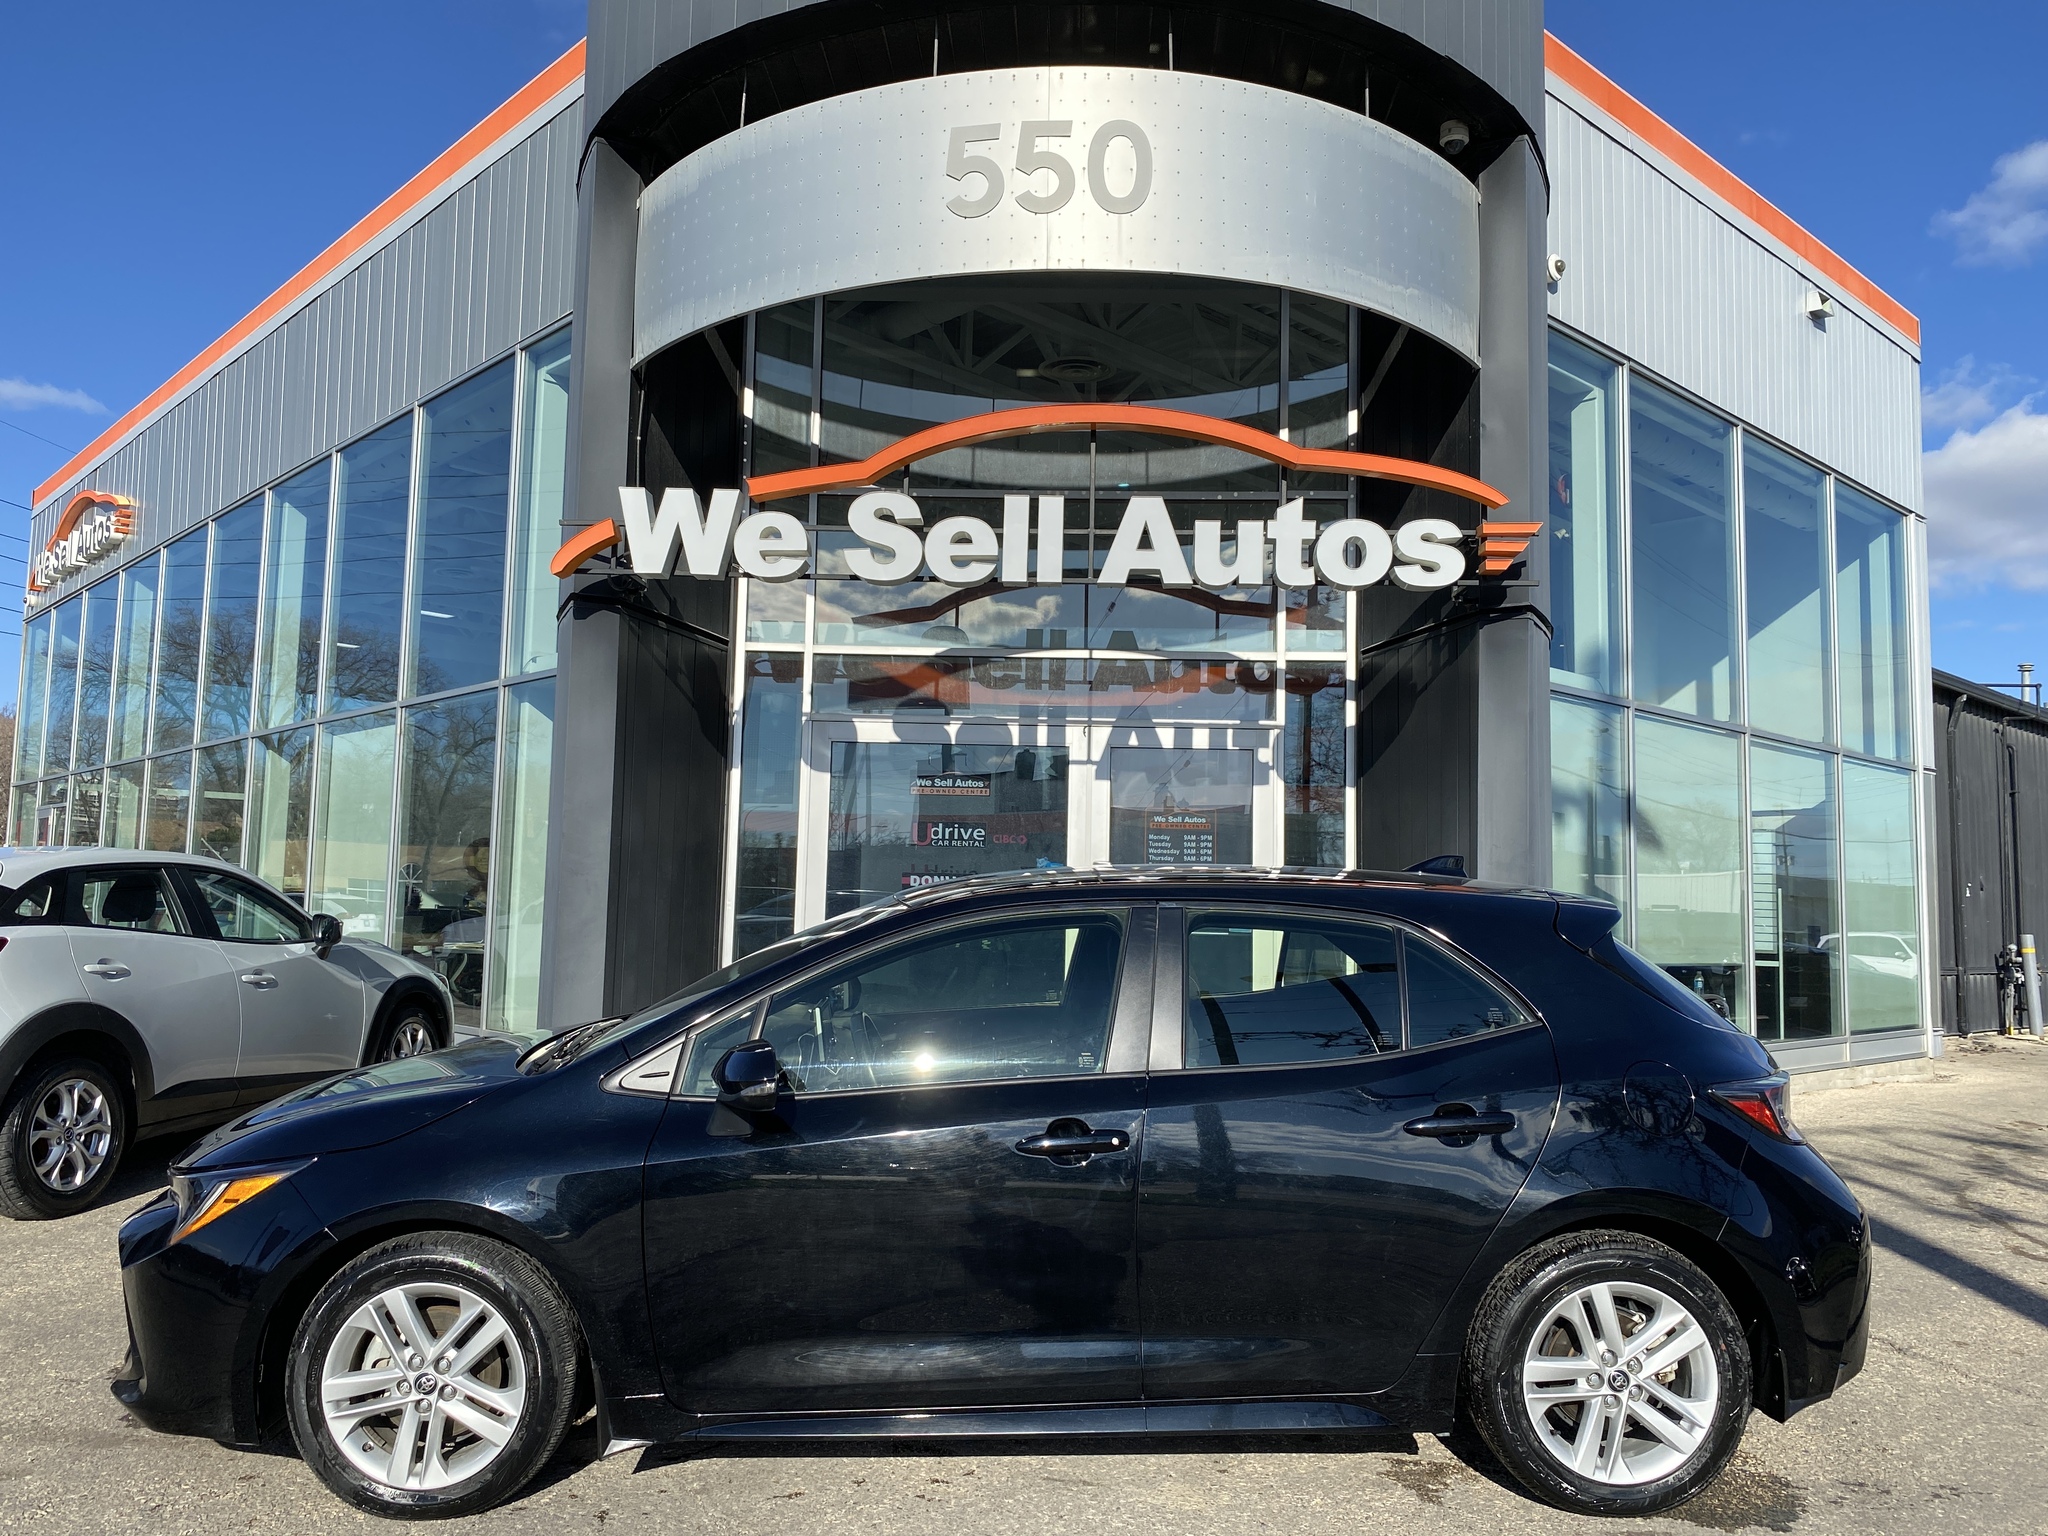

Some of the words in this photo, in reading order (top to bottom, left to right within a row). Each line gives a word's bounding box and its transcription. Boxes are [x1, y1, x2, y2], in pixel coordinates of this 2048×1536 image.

[945, 119, 1153, 218] 550
[619, 487, 811, 583] We
[843, 490, 1065, 587] Sell
[1097, 496, 1466, 592] Autos
[934, 779, 952, 787] Sell
[955, 779, 984, 788] Autos
[1153, 815, 1166, 823] We
[993, 834, 1017, 844] CIBC
[1148, 834, 1170, 842] Monday
[951, 840, 985, 848] RENTAL
